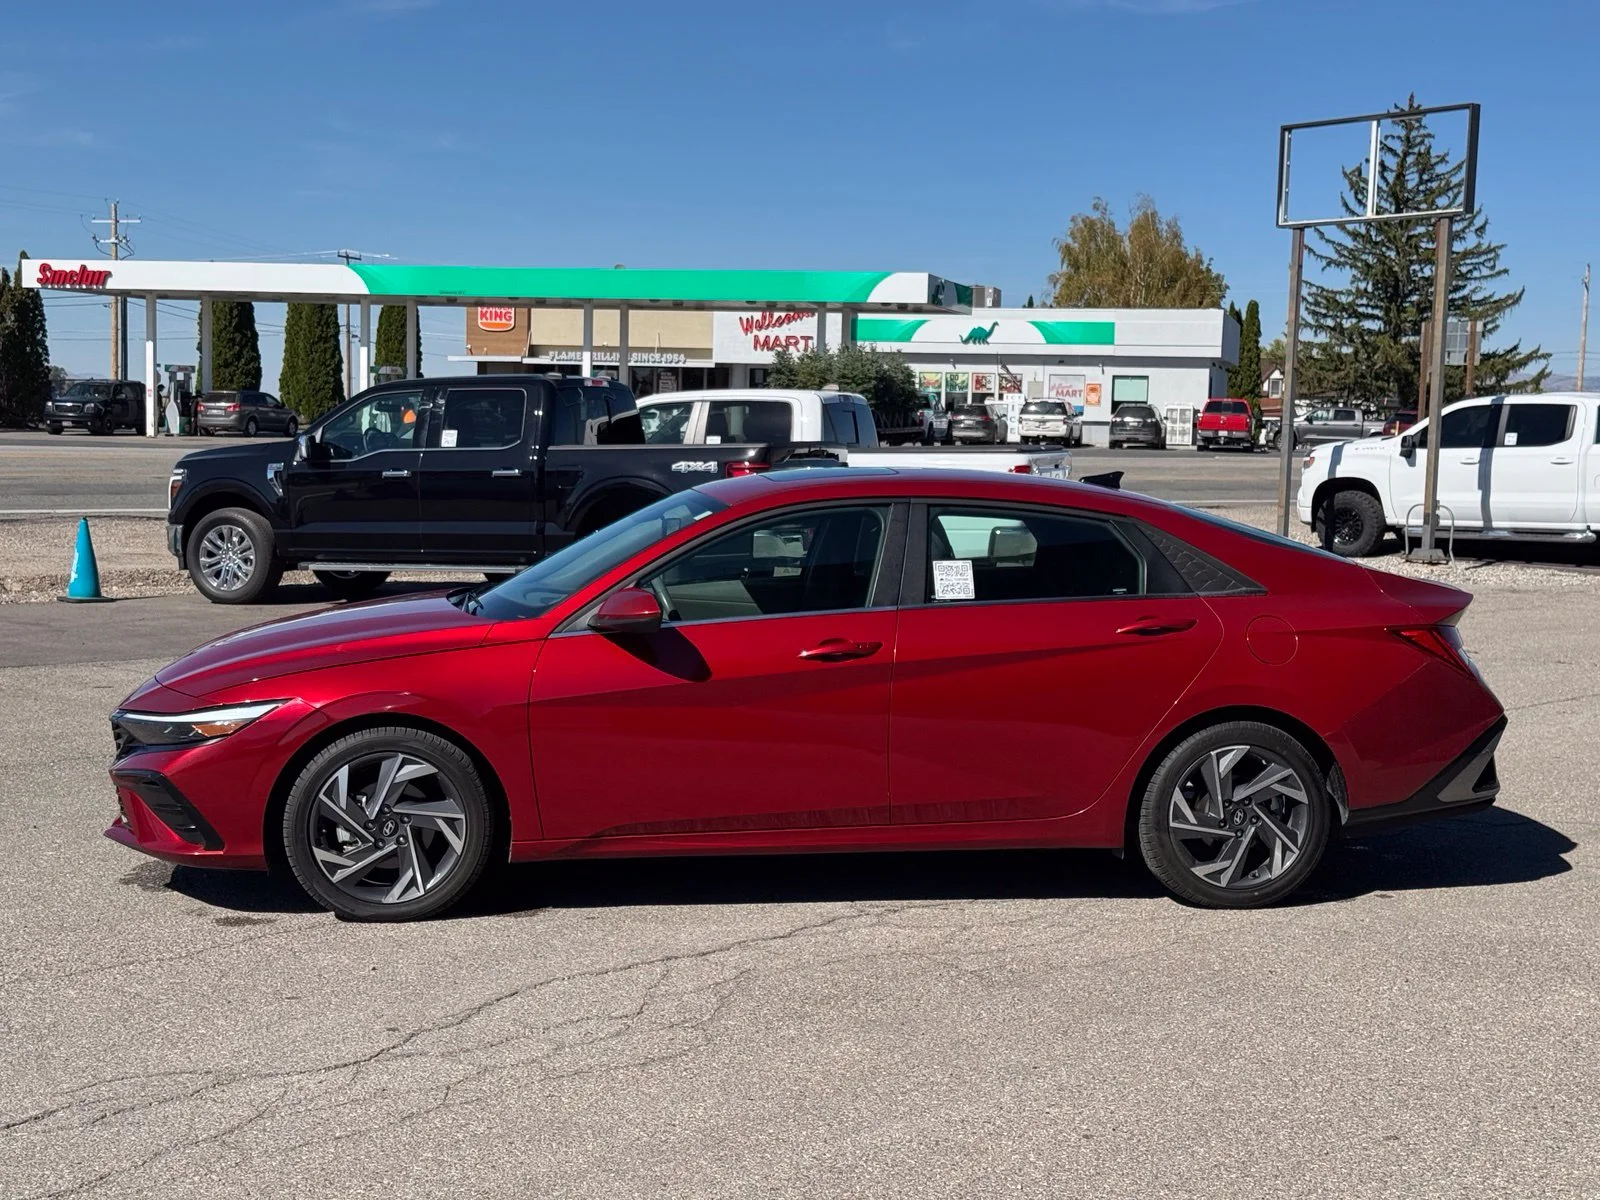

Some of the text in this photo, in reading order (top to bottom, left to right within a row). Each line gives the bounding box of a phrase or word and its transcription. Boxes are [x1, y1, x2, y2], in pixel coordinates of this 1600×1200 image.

[37, 263, 112, 287] Sinclair
[480, 310, 513, 322] KING
[753, 334, 814, 353] MART
[549, 351, 583, 361] FLAME
[631, 352, 661, 364] SINCE
[661, 353, 687, 365] 1954
[1055, 389, 1083, 398] MART
